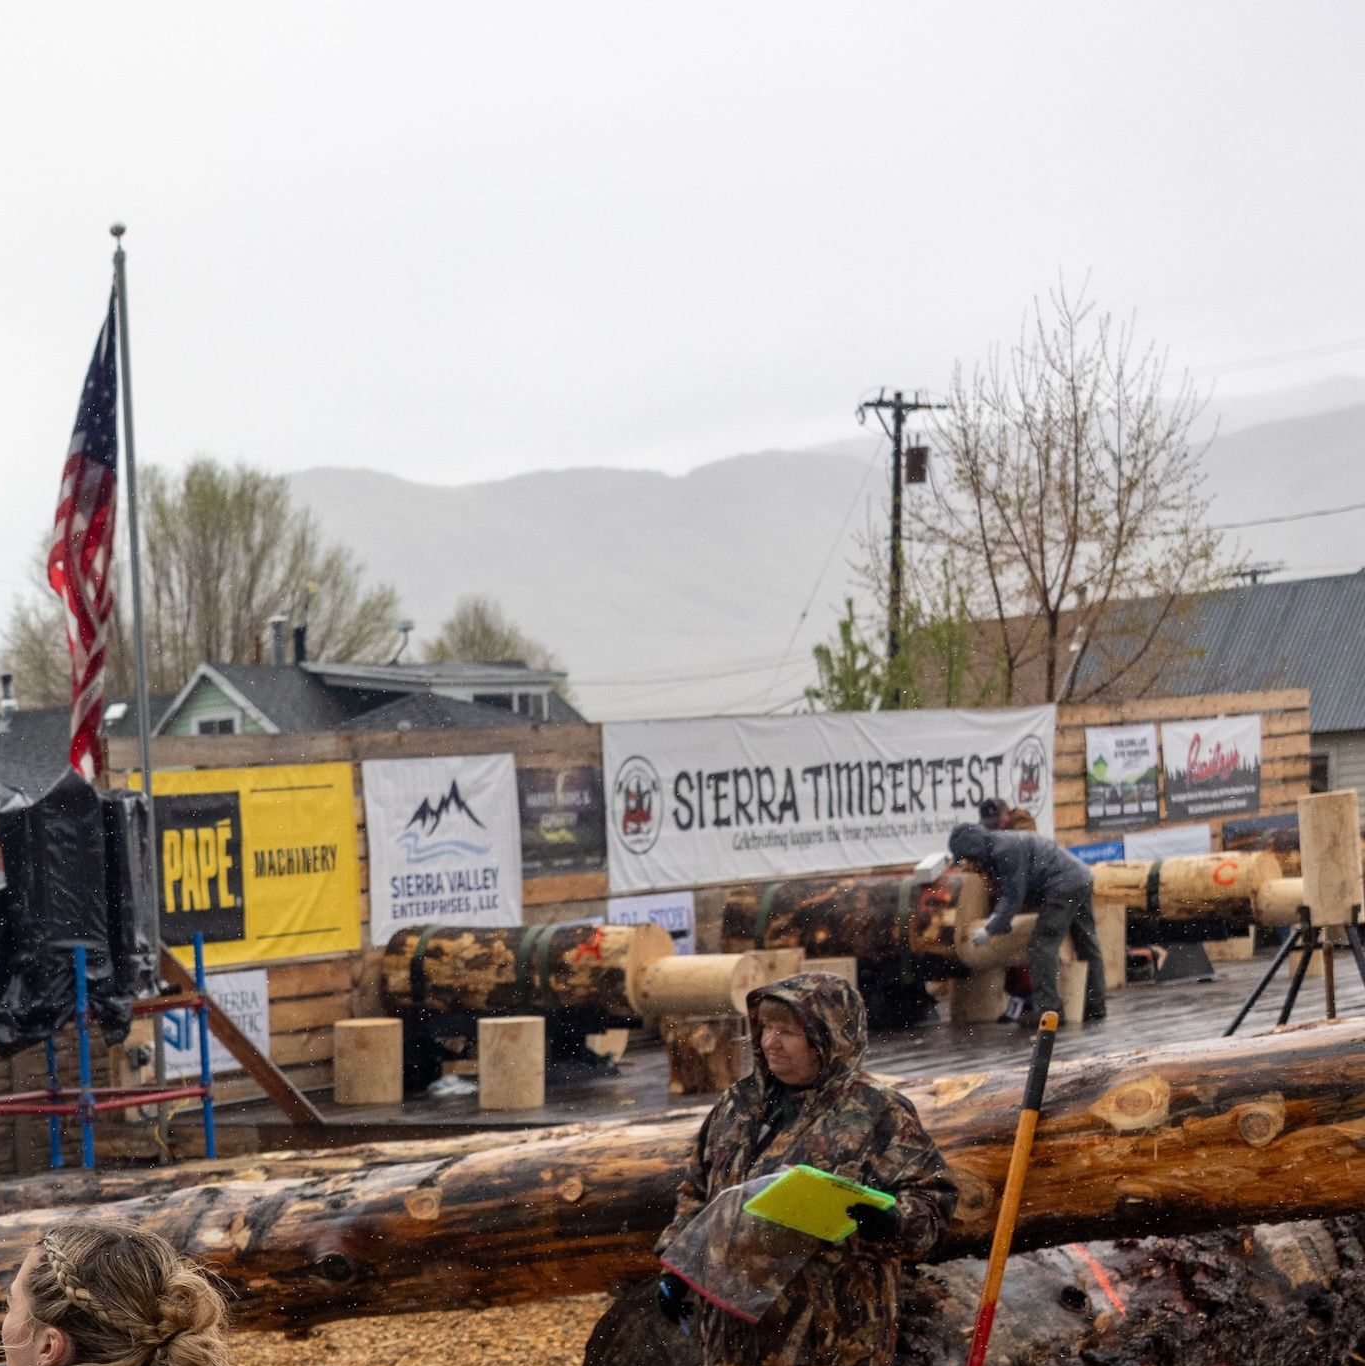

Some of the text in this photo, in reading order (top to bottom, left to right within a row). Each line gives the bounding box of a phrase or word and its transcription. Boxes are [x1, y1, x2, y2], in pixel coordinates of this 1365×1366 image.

[672, 755, 1005, 831] SIERRA TIMBERFEST
[162, 817, 236, 914] PAPÉ
[253, 845, 338, 878] MACHINERY
[1213, 860, 1239, 887] C
[390, 867, 500, 899] SIERRA VALLEY
[479, 895, 499, 911] LLC
[218, 990, 260, 1012] IERRA
